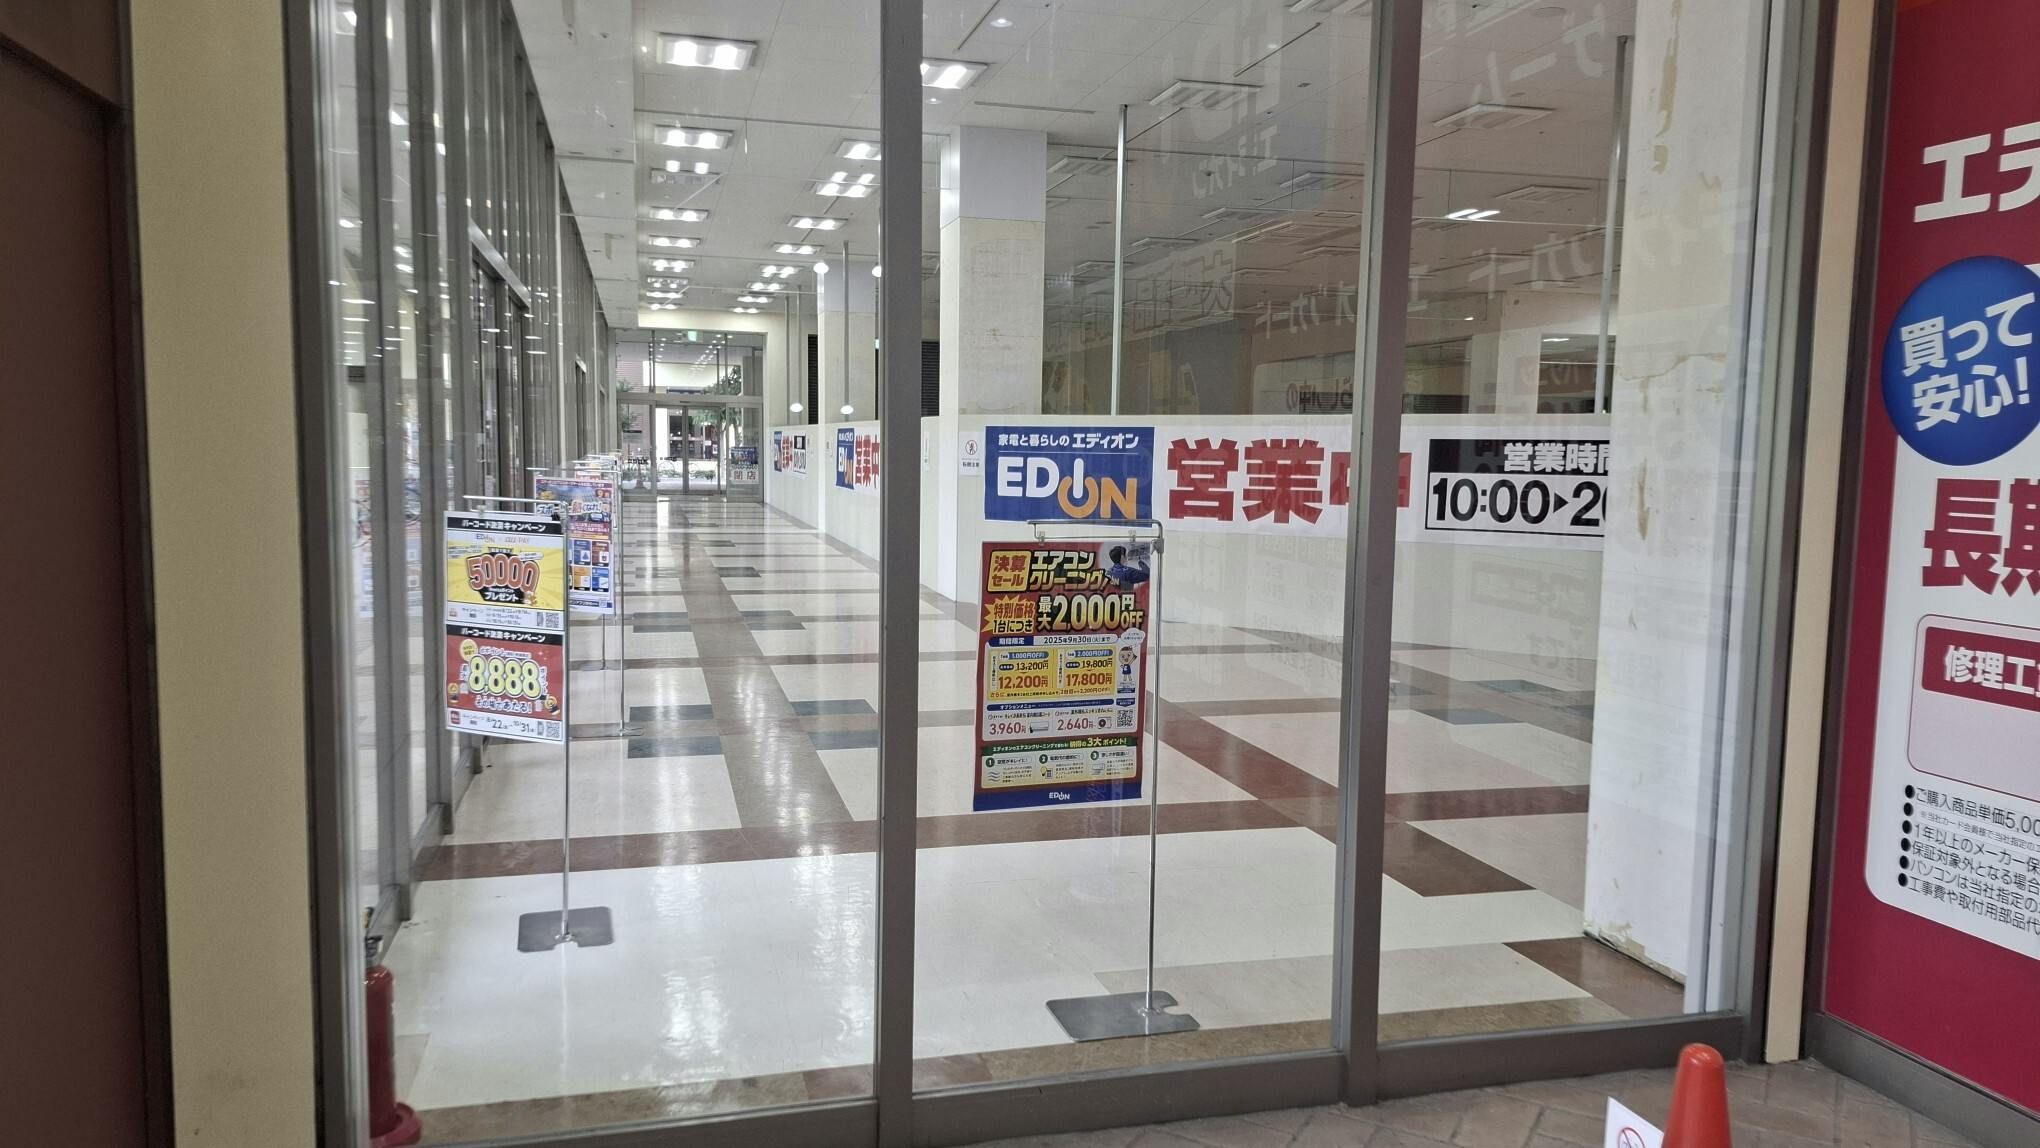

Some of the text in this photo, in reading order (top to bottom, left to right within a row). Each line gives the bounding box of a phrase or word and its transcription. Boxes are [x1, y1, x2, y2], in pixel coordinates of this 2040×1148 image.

[1900, 292, 2036, 377] 買って
[1912, 356, 2030, 431] 安心!
[998, 433, 1139, 449] 家電と暮らしの エディオン
[997, 456, 1138, 520] EDION
[995, 555, 1027, 572] 決算
[1032, 551, 1094, 569] エアコン
[991, 574, 1025, 588] セール
[993, 600, 1035, 619] 特別価格
[993, 619, 1034, 634] 1台につき
[1945, 645, 2040, 698] 修理工
[1910, 859, 2040, 914] パソコンは当社指定の
